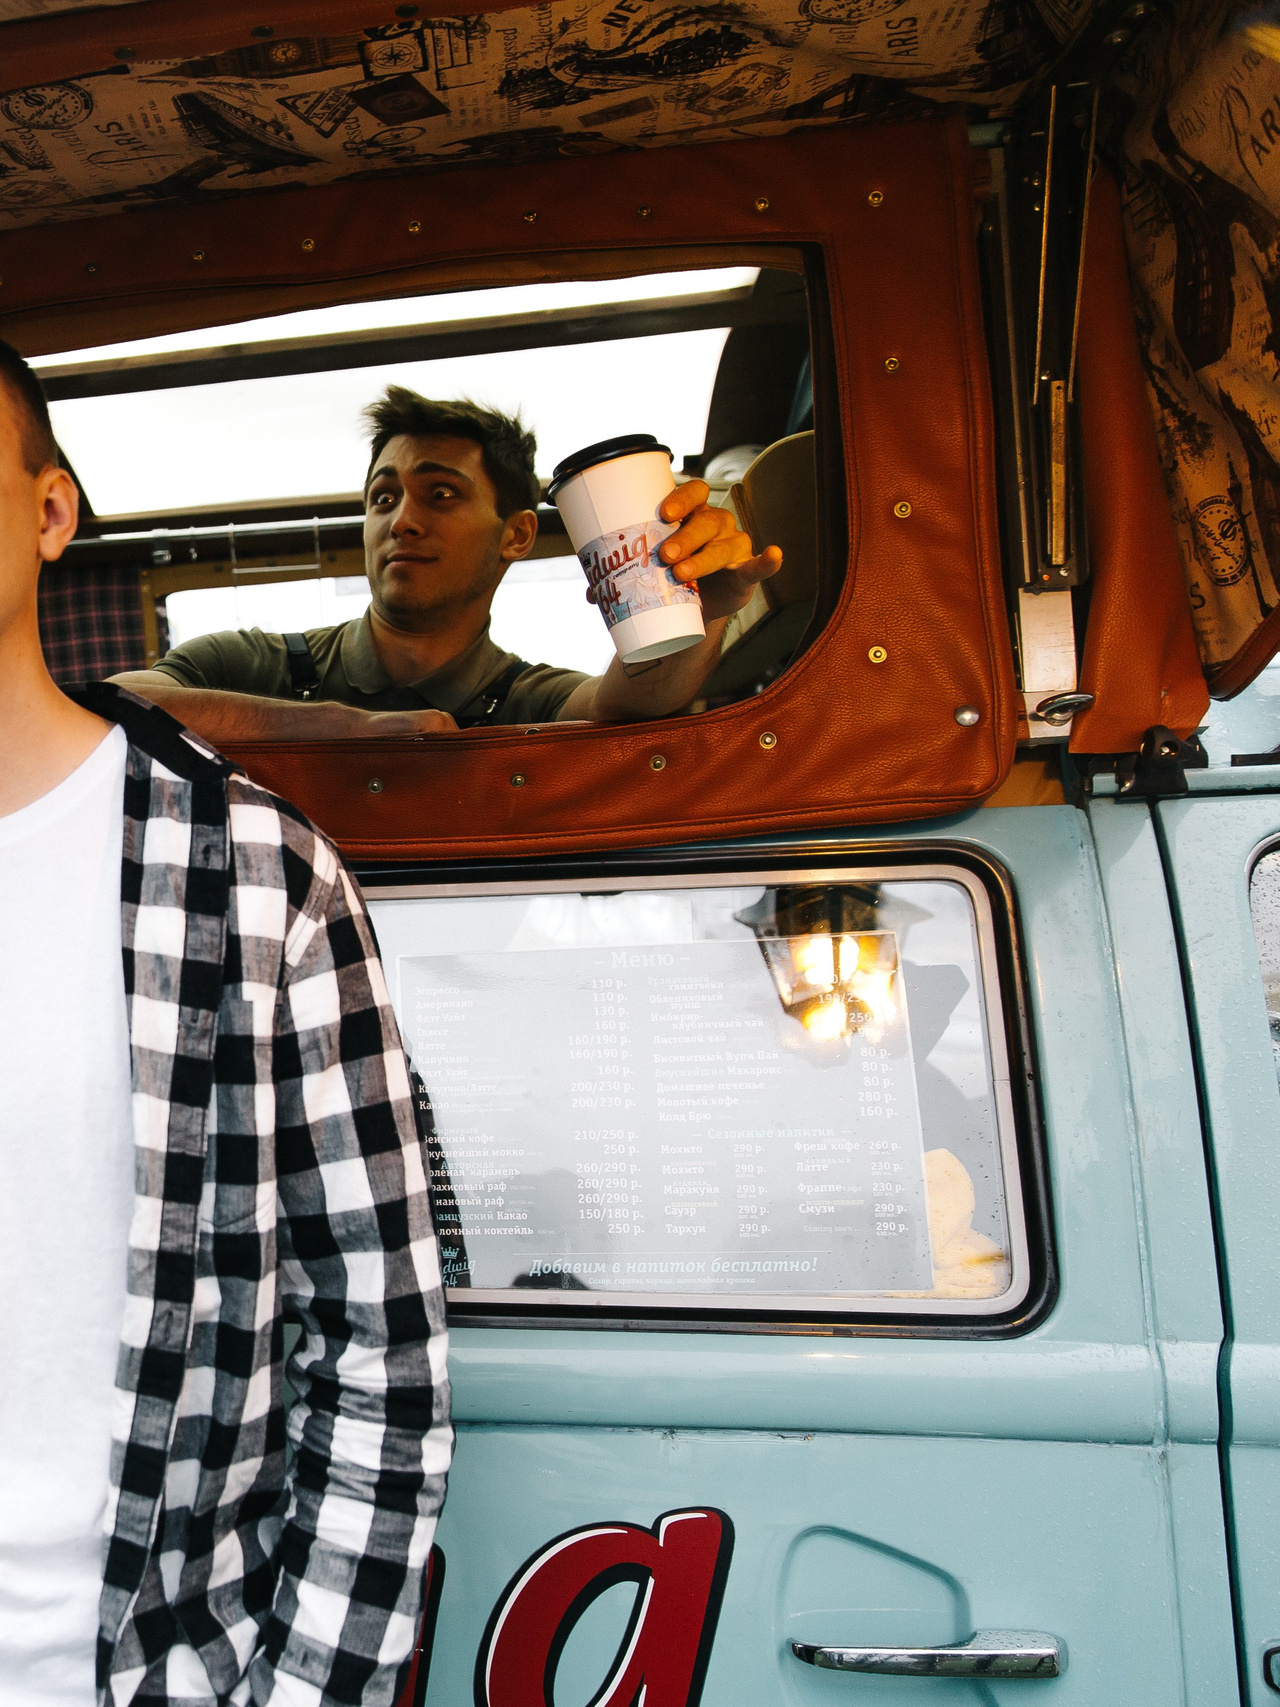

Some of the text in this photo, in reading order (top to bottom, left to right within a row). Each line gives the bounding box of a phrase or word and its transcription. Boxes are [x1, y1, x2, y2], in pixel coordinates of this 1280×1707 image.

[598, 579, 622, 615] 64
[610, 951, 675, 969] Меню
[591, 978, 628, 991] 110 р.
[414, 985, 460, 998] Эспрессо
[592, 992, 628, 1004] 110 р.
[649, 992, 724, 1004] Облепиховый
[415, 998, 474, 1010] Американо
[670, 1000, 702, 1010] пунш
[416, 1012, 466, 1024] Флэт Уайт
[594, 1006, 630, 1018] 130 р.
[650, 1012, 704, 1024] Имбирно-
[595, 1020, 630, 1033] 160 р.
[672, 1018, 764, 1032] клубничный чай
[416, 1026, 449, 1038] Гляссе
[653, 1032, 727, 1045] Листовой чай
[417, 1040, 446, 1052] Латте
[568, 1034, 632, 1047] 160/190 р.
[570, 1048, 632, 1061] 160/190 р.
[654, 1048, 779, 1064] Бисквитный Вупи Пай
[860, 1046, 892, 1060] 80 р.
[418, 1054, 470, 1067] Капучино
[444, 1066, 468, 1078] Уайт
[598, 1064, 634, 1078] 160 р.
[655, 1064, 782, 1080] Вкуснейшие Макаронс
[862, 1062, 893, 1074] 80 р.
[419, 1080, 497, 1096] Капучино/Латте
[571, 1080, 635, 1094] 200/230 р.
[656, 1080, 765, 1094] Домашнее печенье
[864, 1076, 894, 1090] 80 р.
[572, 1096, 636, 1110] 200/230 р.
[657, 1094, 740, 1108] Молотый кофе
[858, 1092, 897, 1104] 280 р.
[419, 1100, 450, 1110] Какао
[659, 1111, 712, 1123] Колд Брю
[860, 1106, 898, 1120] 160 р.
[468, 1132, 495, 1144] кофе
[574, 1130, 639, 1142] 210/250 р.
[707, 1126, 835, 1139] Сезонные напитки
[603, 1144, 640, 1157] 250 р.
[661, 1144, 765, 1154] Мохито 290 р.
[794, 1141, 828, 1153] Фреш
[830, 1140, 860, 1152] кофе
[869, 1140, 888, 1150] 260
[891, 1142, 902, 1152] р.
[426, 1148, 489, 1160] куснейший
[492, 1148, 525, 1158] мокко
[440, 1160, 494, 1172] Авторская
[470, 1167, 521, 1178] карамель
[576, 1162, 641, 1175] 260/290 р.
[662, 1164, 766, 1175] Мохито 290 р.
[796, 1161, 904, 1172] Латте 230 р.
[431, 1182, 485, 1192] рахисовый
[486, 1181, 507, 1193] раф
[577, 1178, 642, 1191] 260/290 р.
[736, 1184, 756, 1194] 290
[758, 1186, 768, 1195] р.
[797, 1182, 906, 1194] Фраппе 230 р.
[436, 1196, 482, 1206] нановый
[484, 1196, 505, 1208] раф
[578, 1193, 643, 1206] 260/290 р.
[496, 1210, 528, 1221] Какао
[579, 1208, 644, 1221] 150/180 р.
[664, 1205, 770, 1217] Сауэр 290 р.
[798, 1203, 908, 1216] Смузи 290 р.
[438, 1225, 534, 1236] лочный коктейль
[608, 1224, 645, 1237] 250 р.
[666, 1223, 772, 1236] Тархун 290 р.
[803, 1224, 833, 1234] Coming
[876, 1222, 909, 1233] 290 р.
[441, 1256, 476, 1276] dwig
[530, 1256, 819, 1276] Добавим в напиток бесплатно!
[726, 1276, 756, 1285] крошка
